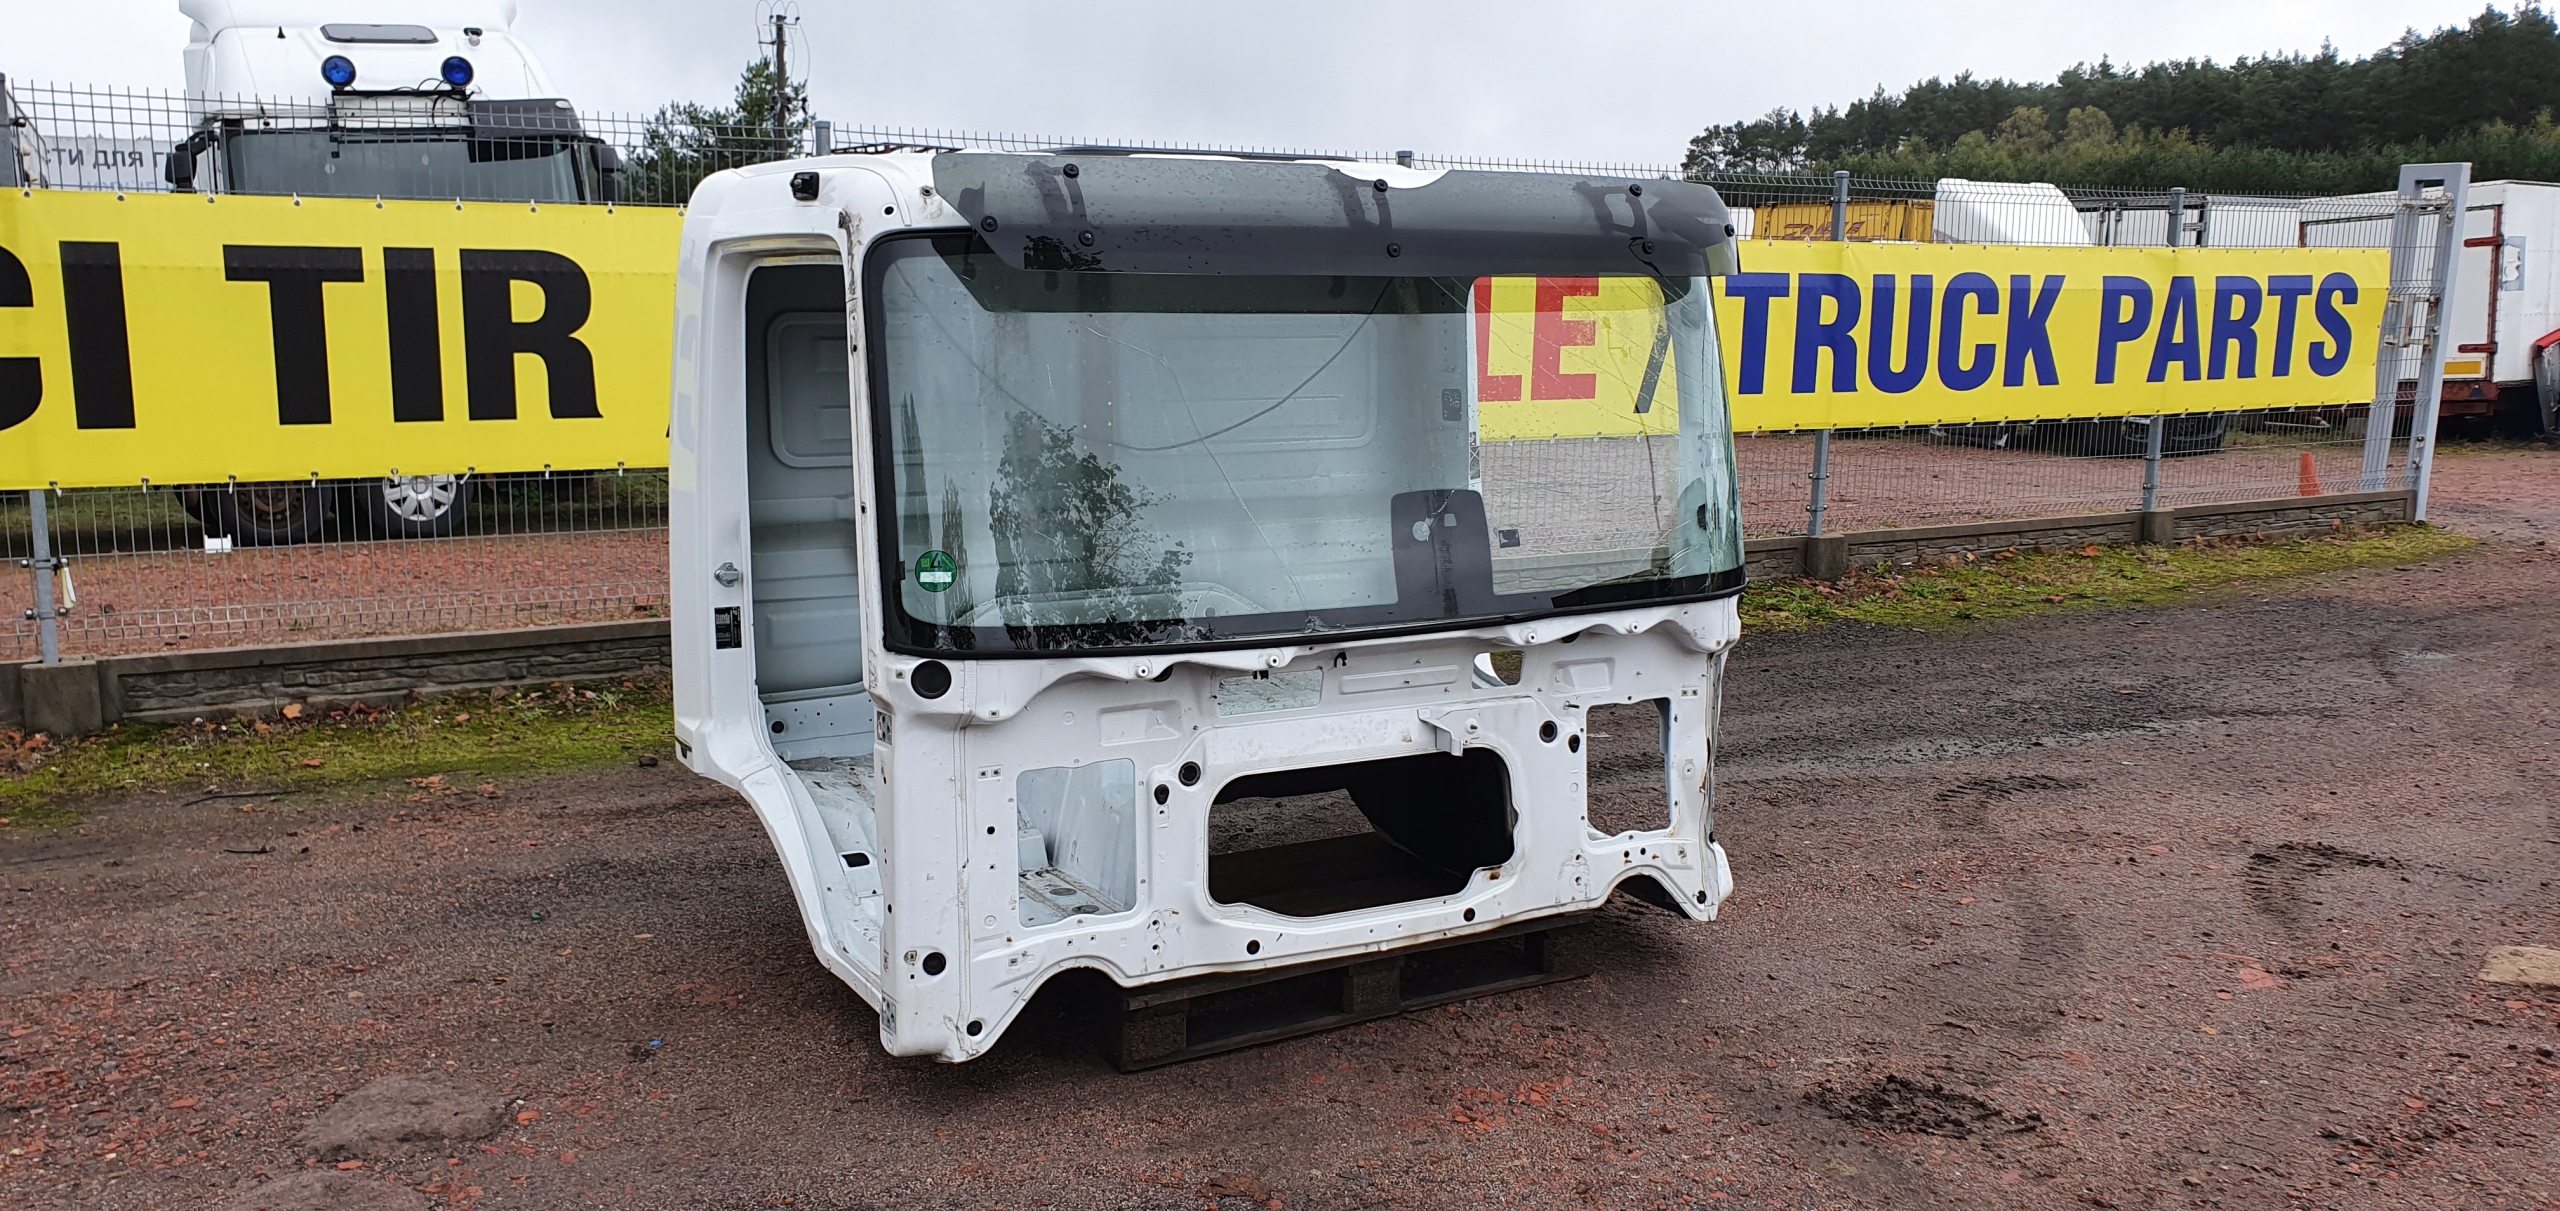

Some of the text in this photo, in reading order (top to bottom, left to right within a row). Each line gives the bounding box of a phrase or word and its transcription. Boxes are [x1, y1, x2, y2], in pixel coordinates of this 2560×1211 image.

[222, 244, 604, 426] TIR
[1724, 272, 2067, 395] TRUCK
[2094, 272, 2360, 384] PARTS
